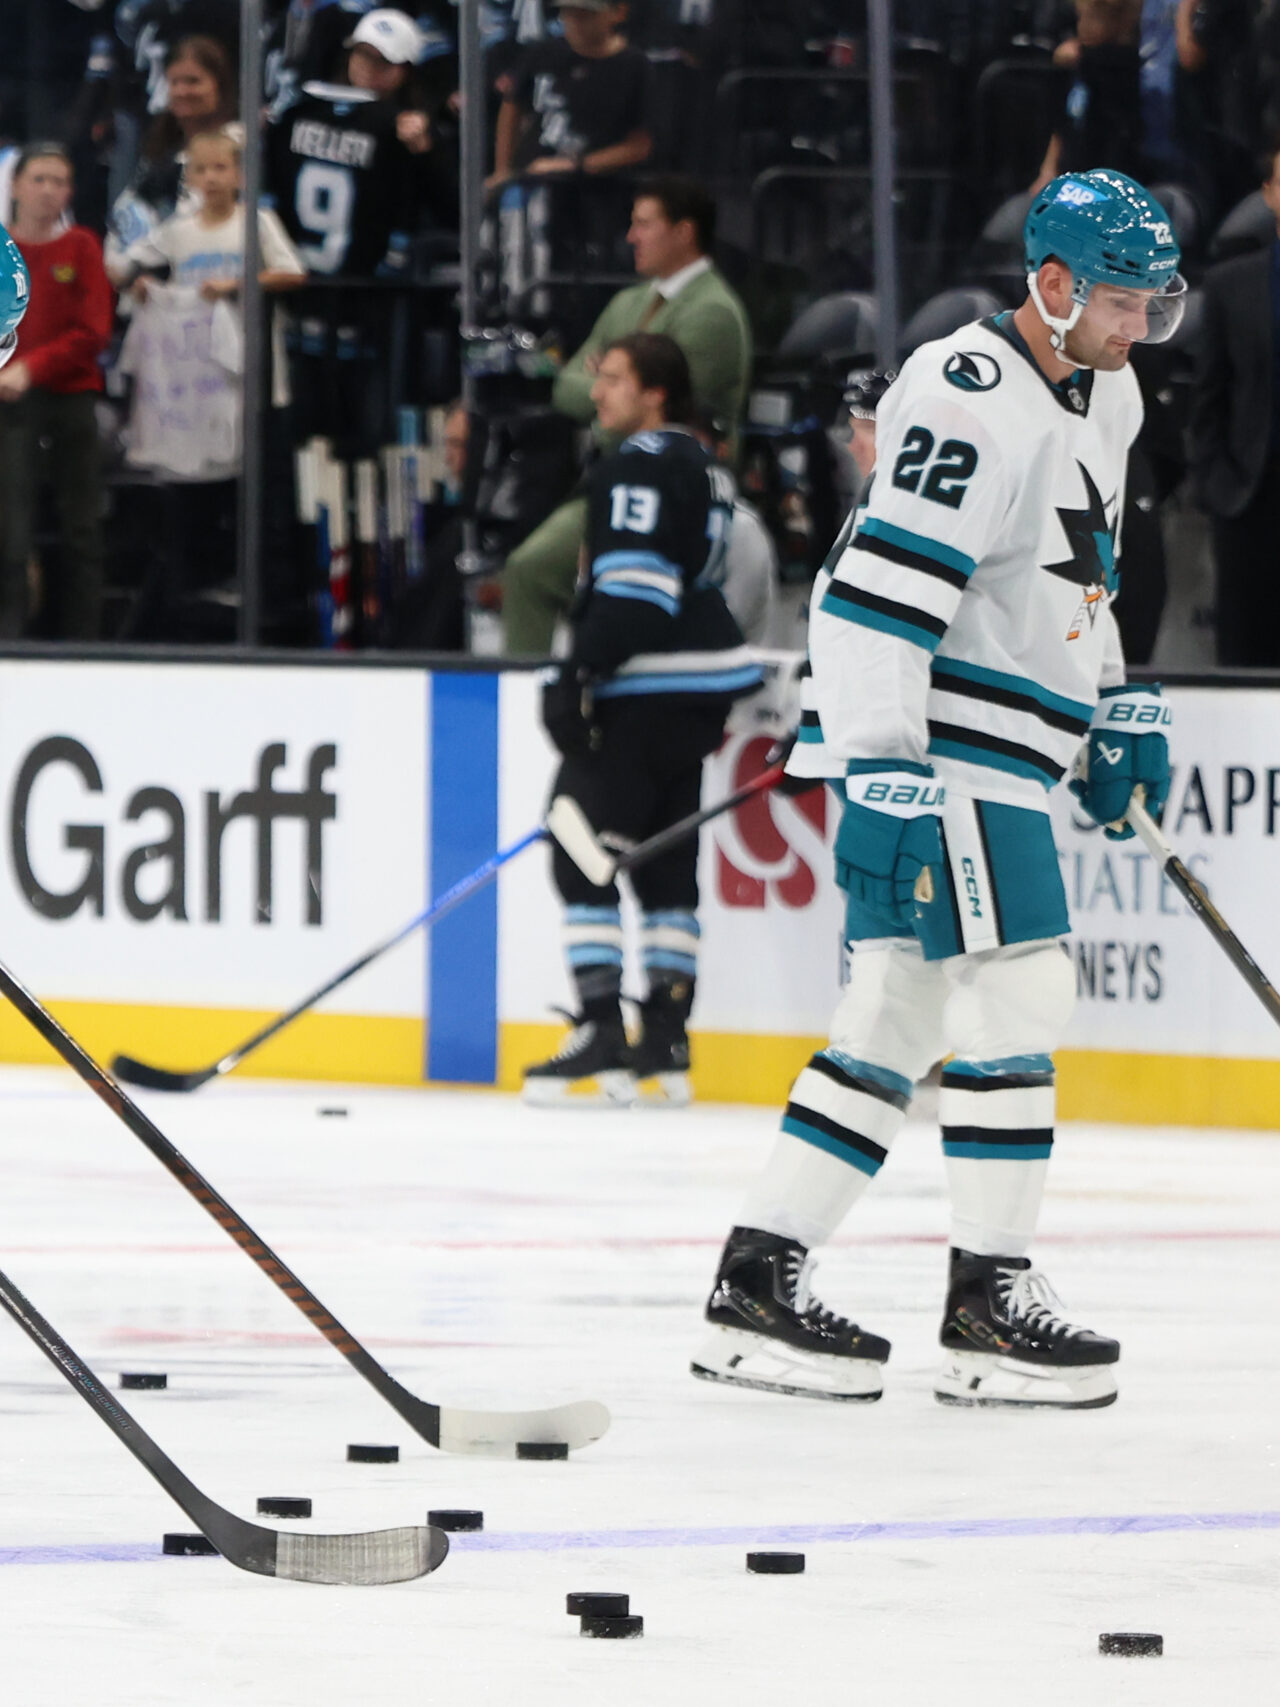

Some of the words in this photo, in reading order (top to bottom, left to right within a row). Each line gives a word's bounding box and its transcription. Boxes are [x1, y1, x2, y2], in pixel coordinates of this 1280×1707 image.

[295, 163, 356, 274] 9
[1056, 183, 1095, 206] SAP
[1148, 258, 1177, 271] CCM
[891, 425, 978, 510] 22
[609, 483, 661, 535] 13
[6, 734, 337, 927] Garff
[961, 856, 983, 919] CCM
[1059, 941, 1163, 1001] NEYS
